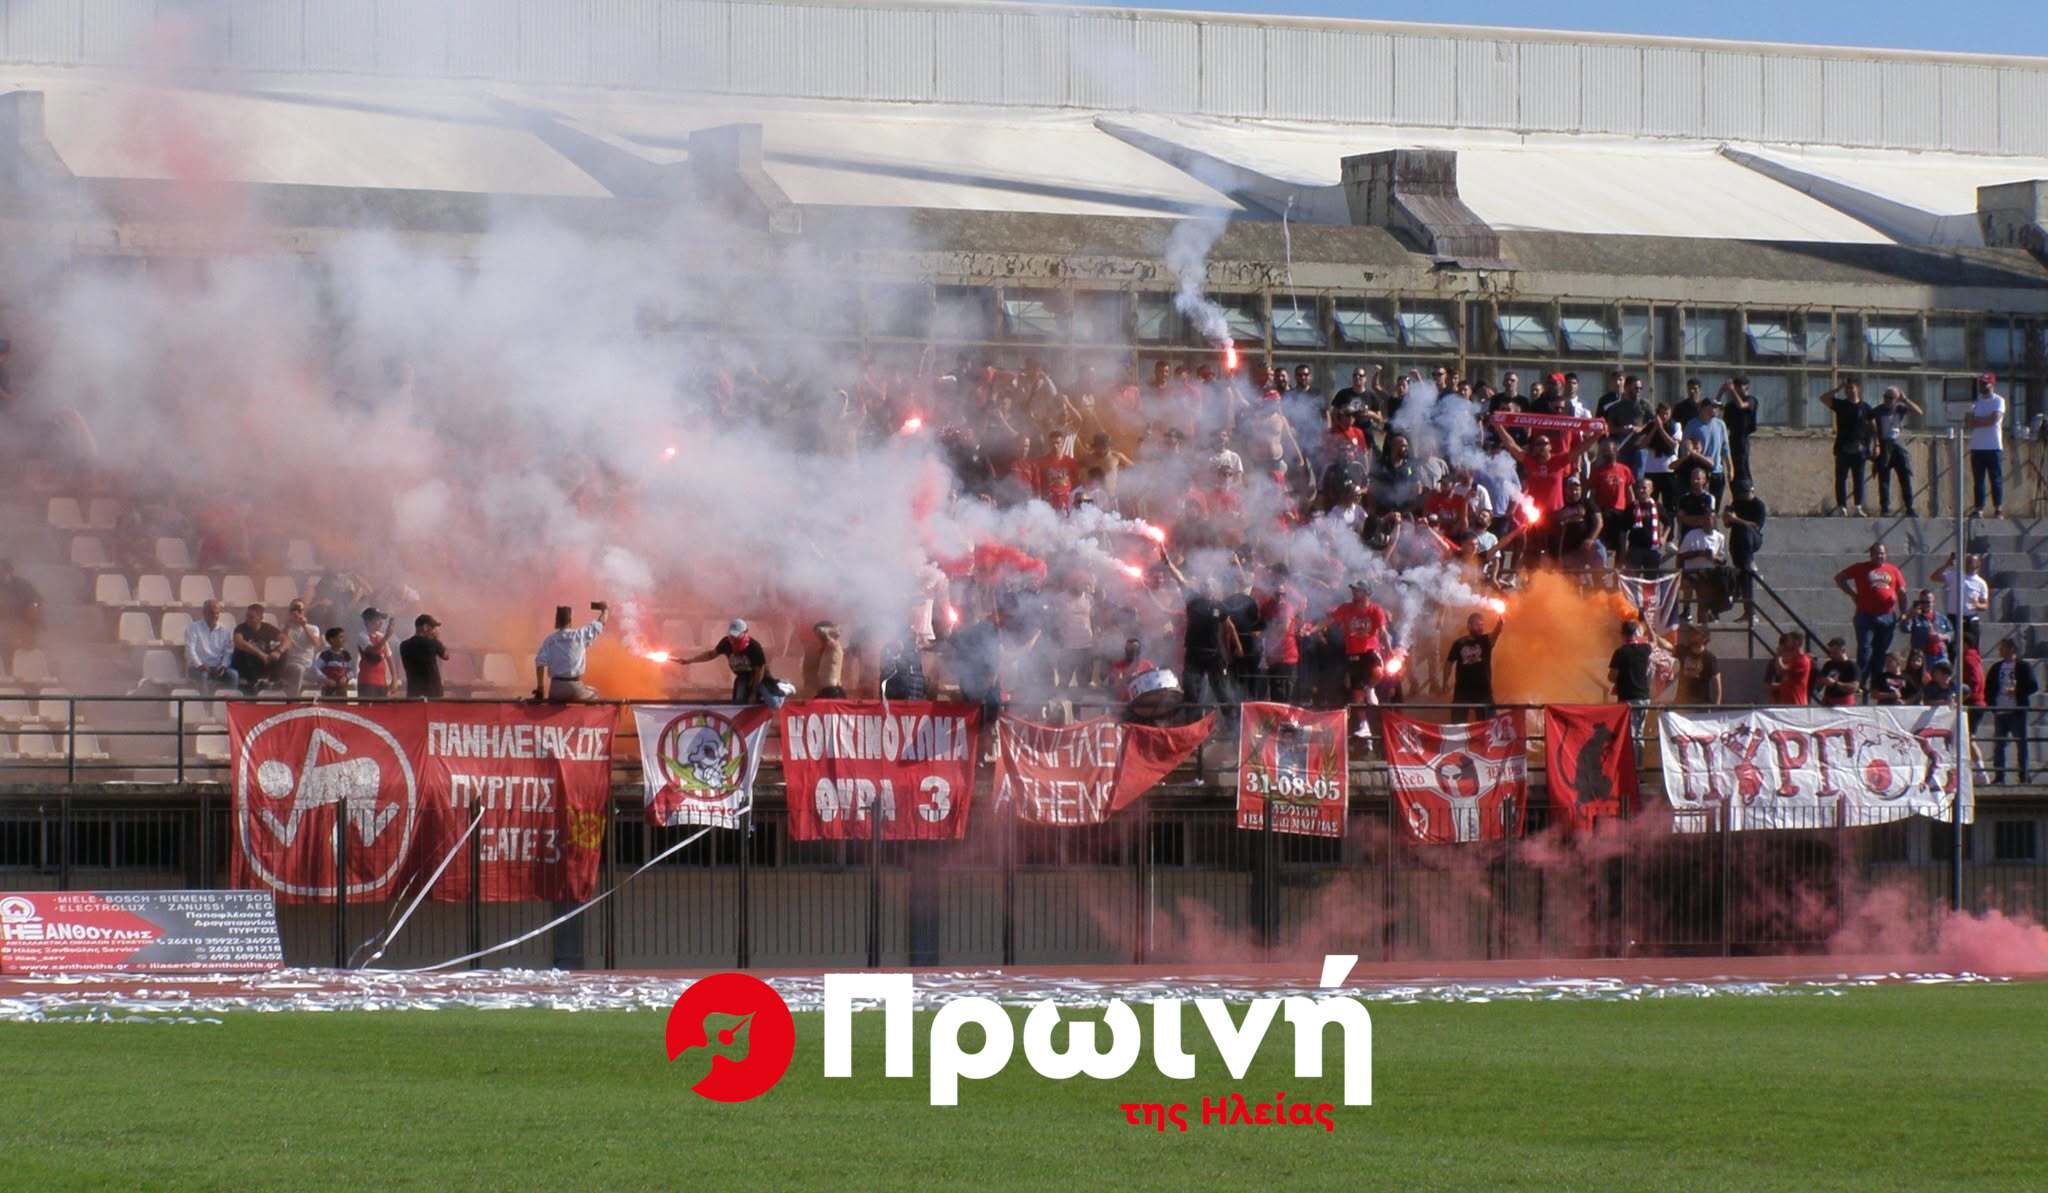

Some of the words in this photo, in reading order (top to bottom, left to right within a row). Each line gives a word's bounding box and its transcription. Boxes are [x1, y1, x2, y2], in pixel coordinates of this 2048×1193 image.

[428, 722, 609, 761] ΠΑΝΗΛΕΙΑΚΟΣ
[451, 774, 555, 813] ΠΥΡΓΟΣ
[815, 777, 897, 823] ΘΥΡΑ
[919, 775, 951, 823] 3
[1245, 772, 1340, 800] 31-08-05
[480, 827, 538, 861] GATE
[544, 828, 560, 863] 3
[57, 895, 97, 904] MIELE
[105, 895, 150, 904] BOSCH
[159, 895, 216, 903] SIEMENS
[224, 894, 272, 902] PITSOS
[59, 904, 146, 912] ELECTROLUX
[168, 903, 225, 911] ZANUSSI
[246, 903, 273, 911] AEG
